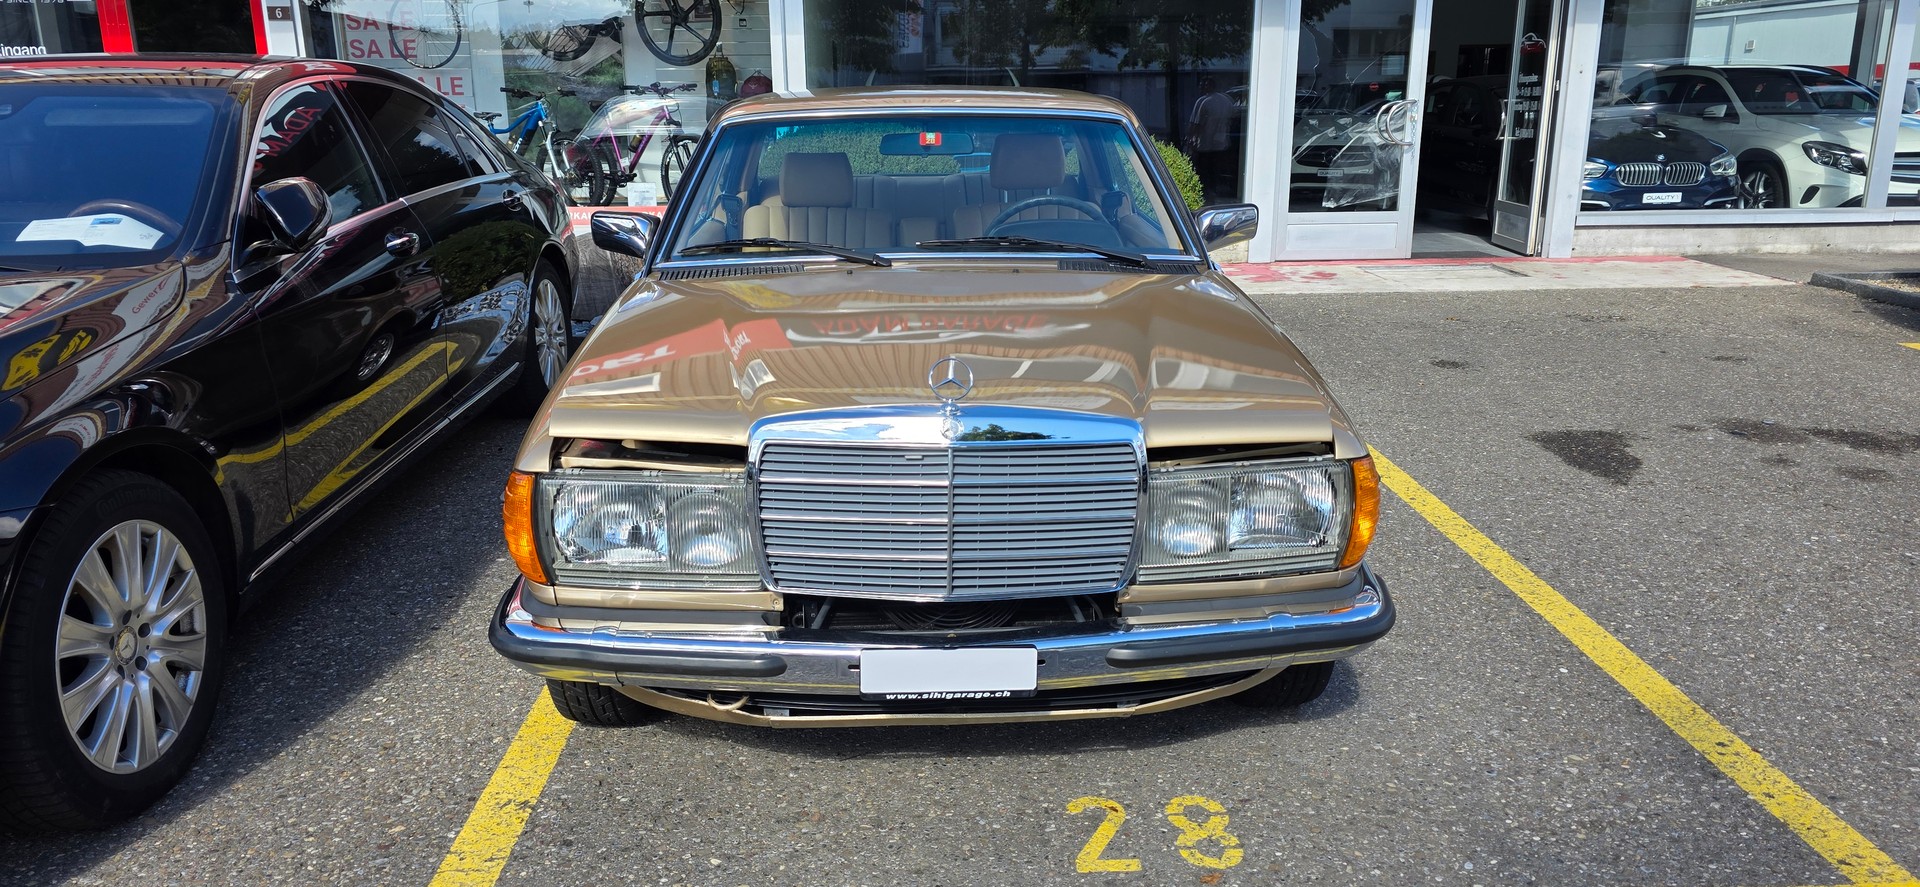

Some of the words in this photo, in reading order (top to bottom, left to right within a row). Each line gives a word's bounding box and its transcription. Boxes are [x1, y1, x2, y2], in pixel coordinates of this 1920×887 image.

[275, 7, 283, 19] 6
[886, 691, 1011, 700] www.sihlgarage.ch
[1066, 795, 1244, 873] 28
